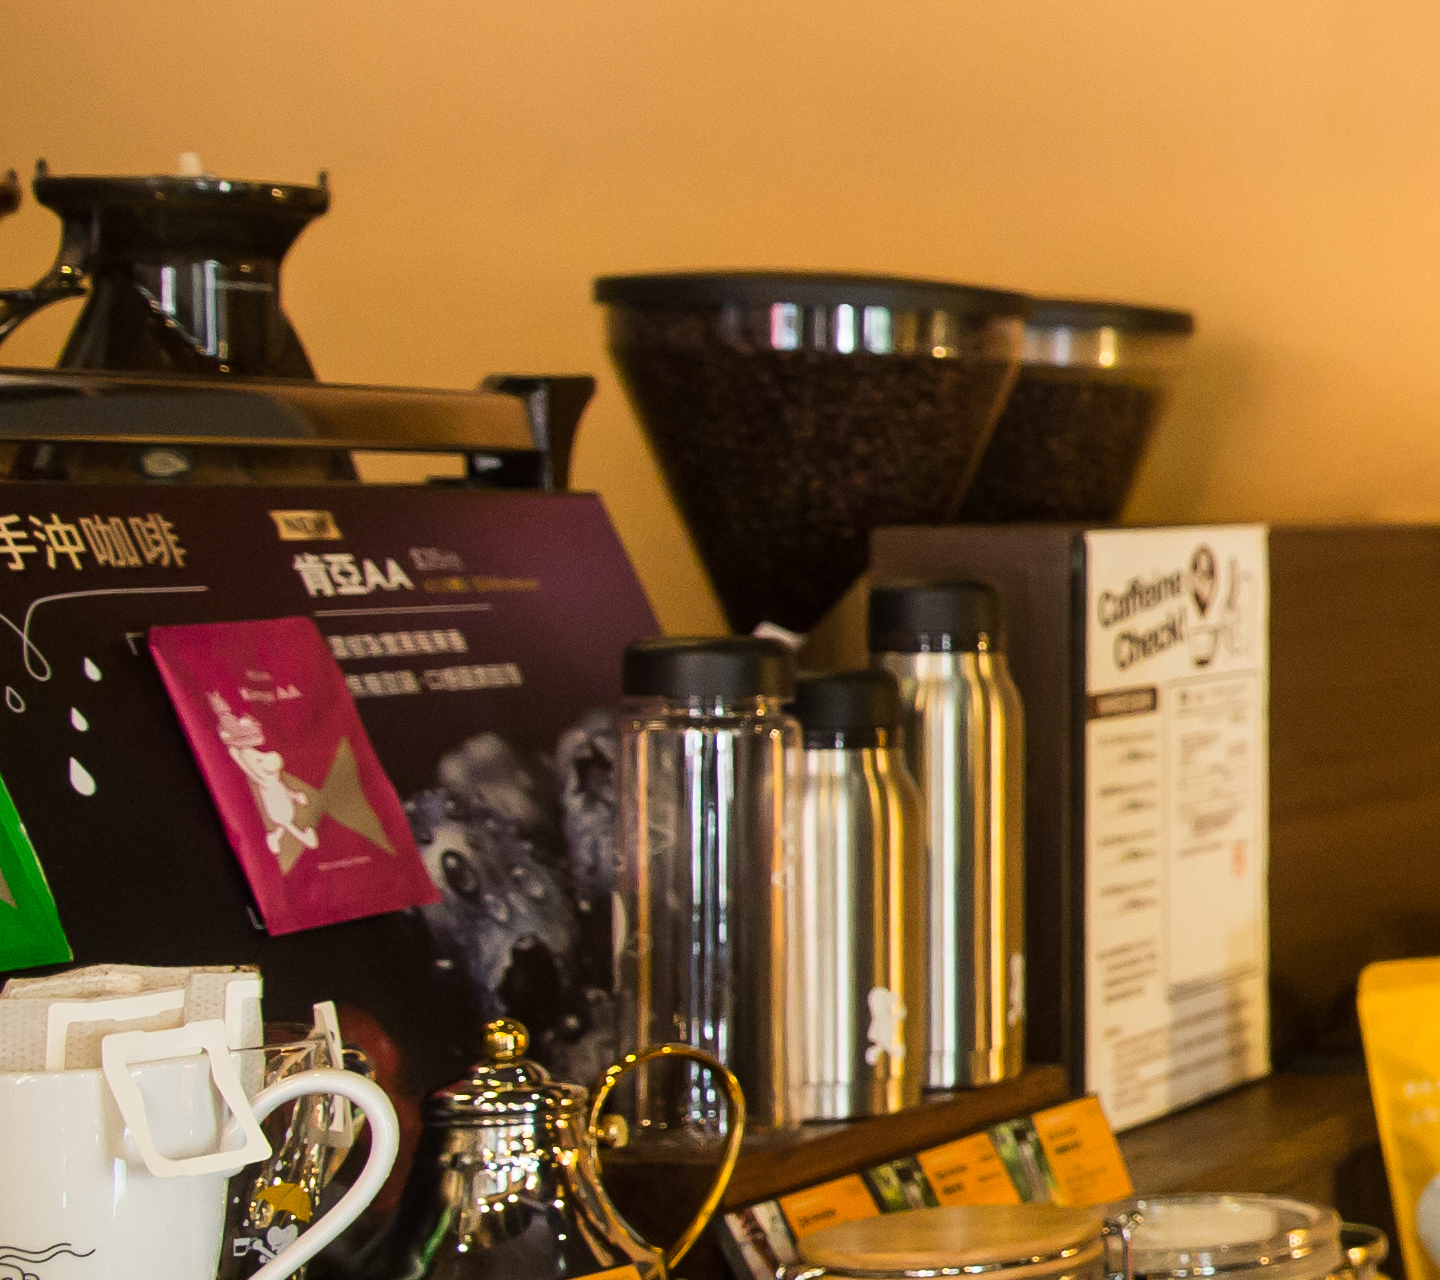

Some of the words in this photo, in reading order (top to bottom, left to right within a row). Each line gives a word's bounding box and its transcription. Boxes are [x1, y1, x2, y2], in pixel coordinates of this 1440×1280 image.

[0, 513, 187, 570] 手沖咖啡
[292, 552, 415, 598] 肯亞AA
